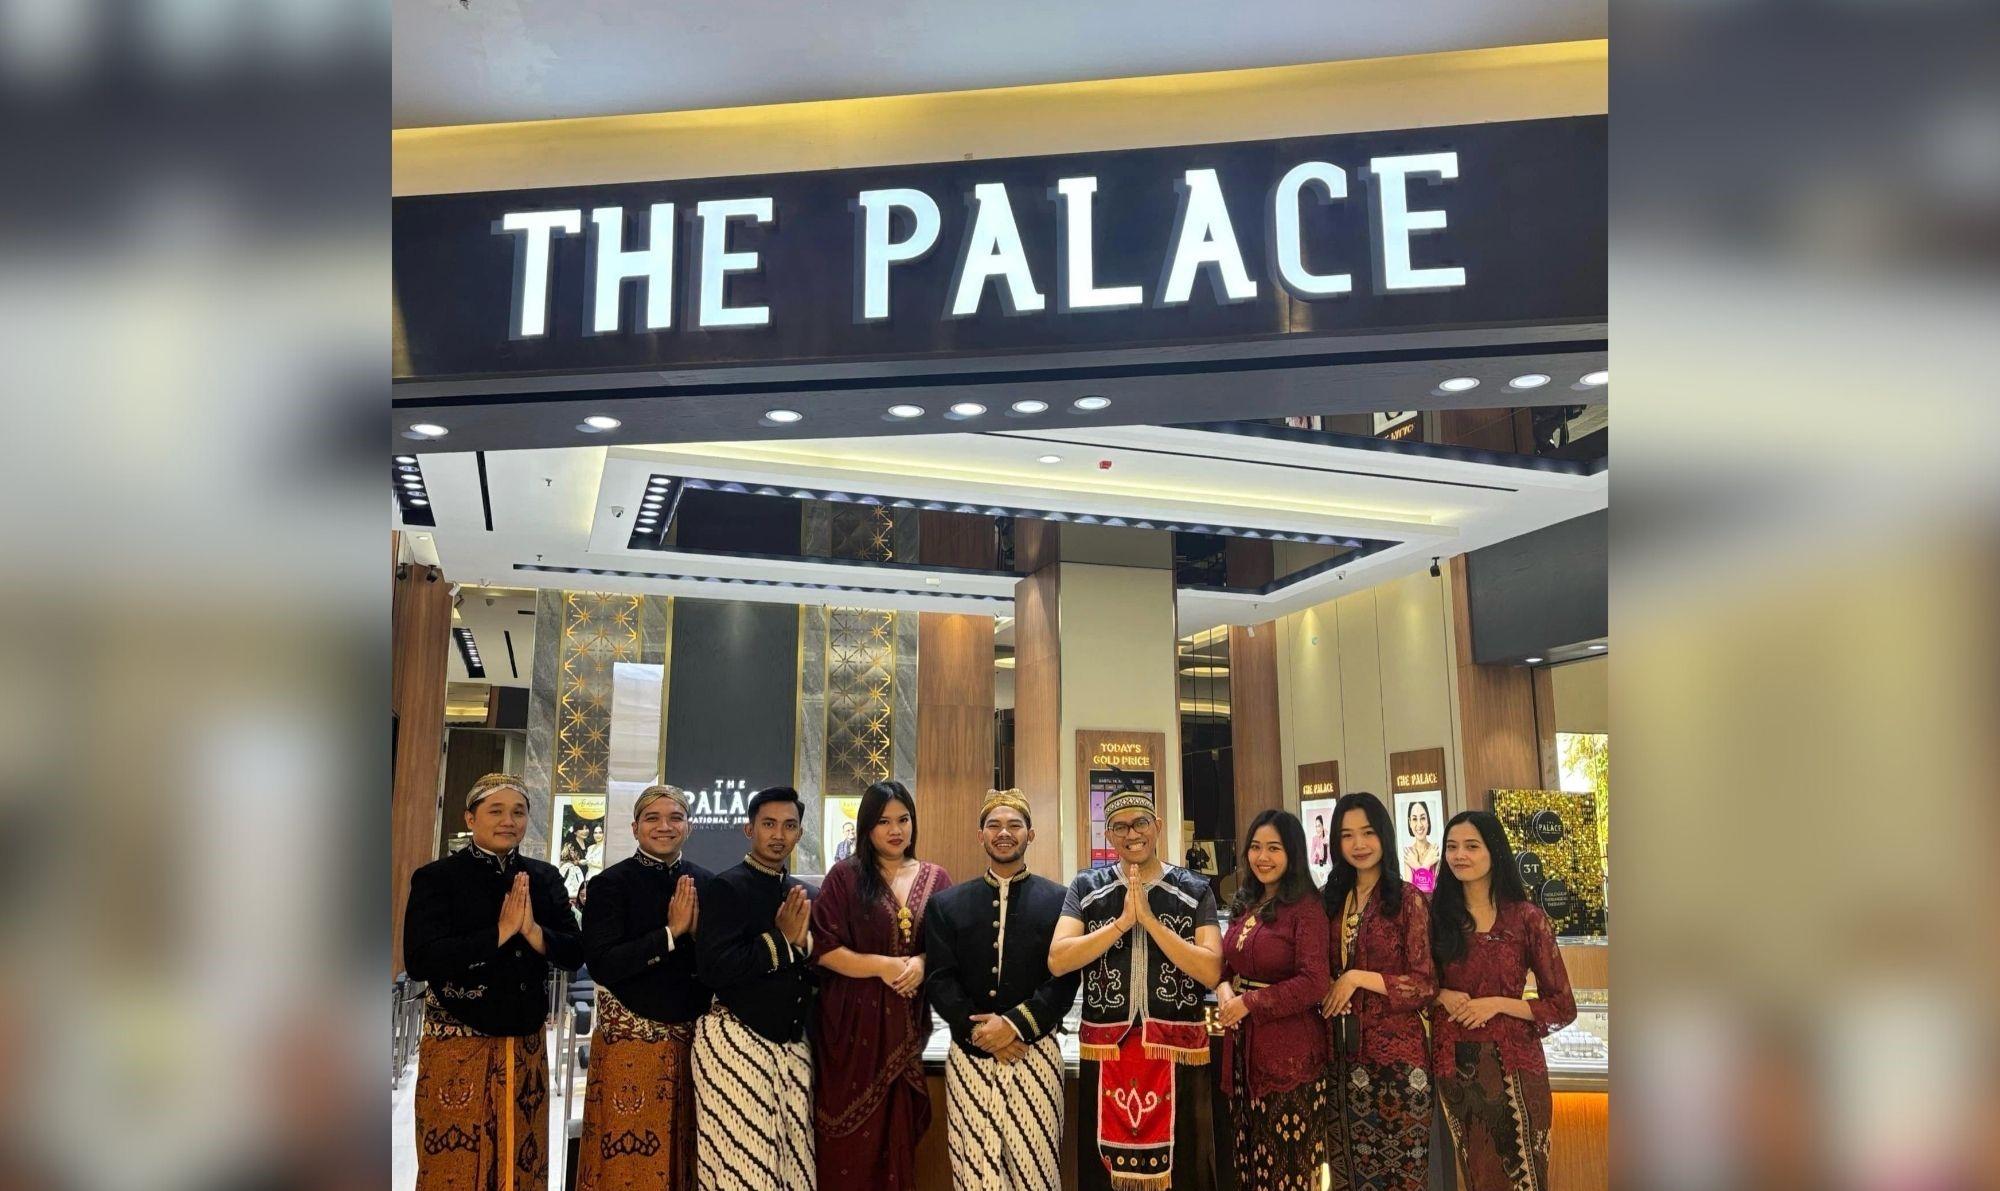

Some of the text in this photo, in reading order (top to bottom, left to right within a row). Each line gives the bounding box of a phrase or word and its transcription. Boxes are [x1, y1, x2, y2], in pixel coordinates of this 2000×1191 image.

[502, 151, 1467, 337] THE PALACE
[1100, 743, 1142, 753] TODAY'S
[1093, 755, 1150, 766] GOLD PRICE
[715, 779, 746, 789] THE
[1396, 772, 1438, 787] THE PALACE
[1313, 782, 1334, 794] PALACE
[682, 790, 760, 815] PALA
[733, 816, 750, 825] JEW
[1538, 824, 1562, 832] PALACE
[1523, 864, 1540, 874] 3T
